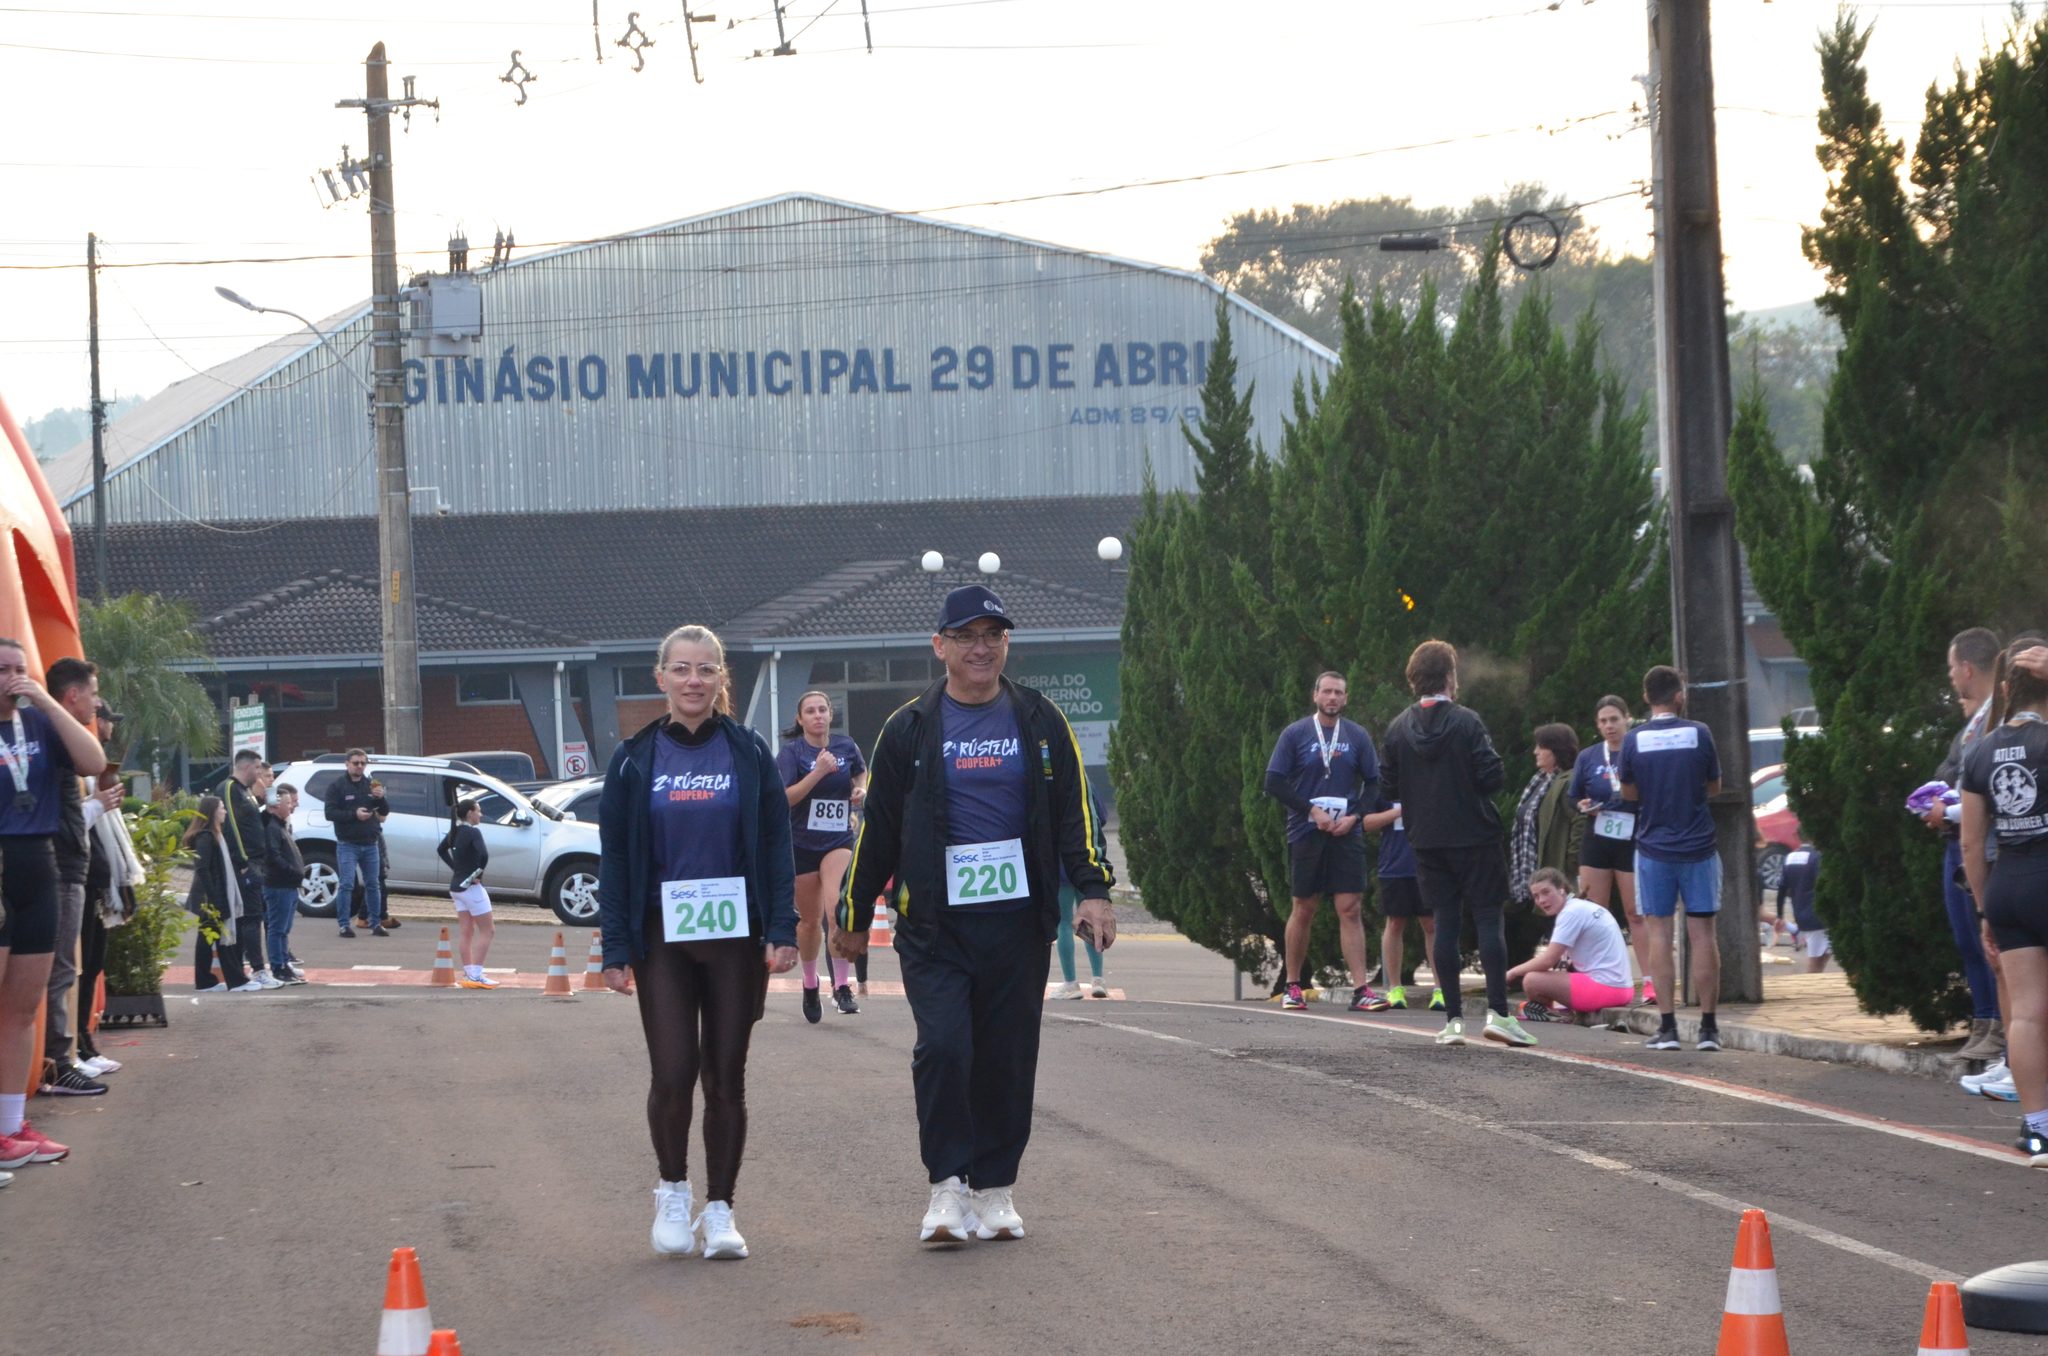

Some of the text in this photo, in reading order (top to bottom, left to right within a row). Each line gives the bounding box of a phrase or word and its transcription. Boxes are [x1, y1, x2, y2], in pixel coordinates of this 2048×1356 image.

[400, 340, 1237, 405] GINÁSIO MUNICIPAL 29 DE ABRI
[1017, 673, 1086, 688] OBRA DO
[1040, 687, 1092, 700] VERNO
[1056, 701, 1103, 714] TADO
[960, 737, 1018, 757] RÚSTICA
[1994, 745, 2027, 763] ATLETA
[673, 771, 731, 791] RÚSTICA
[815, 802, 845, 820] 938
[1604, 819, 1633, 836] 81
[957, 862, 1018, 899] 220
[675, 899, 737, 935] 240
